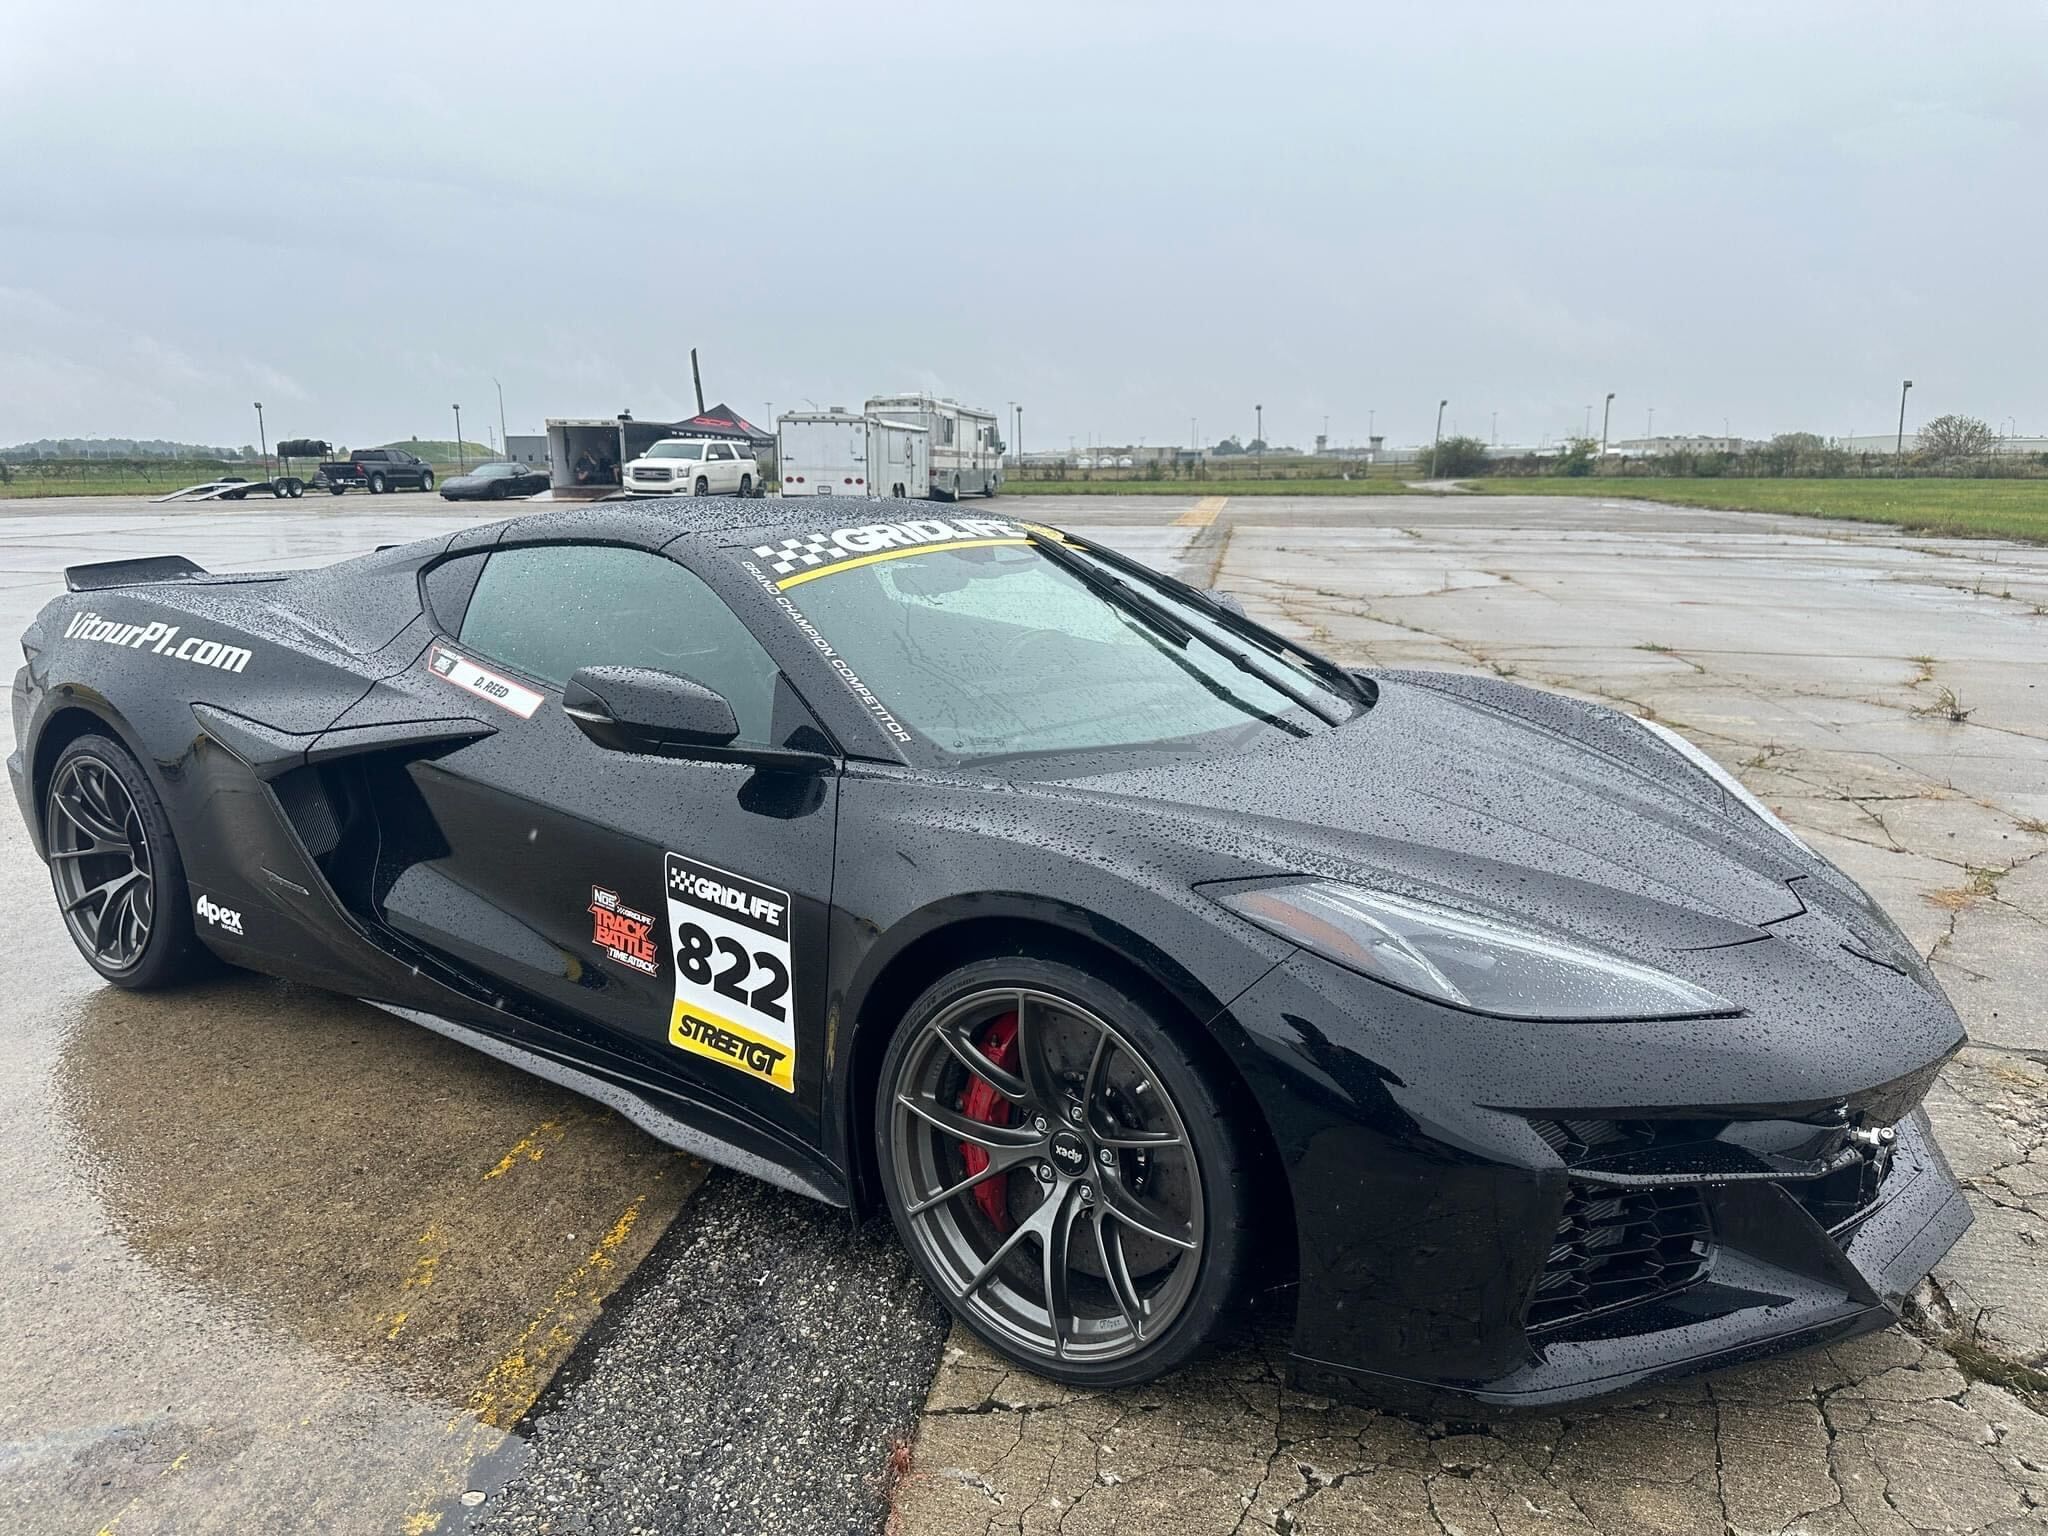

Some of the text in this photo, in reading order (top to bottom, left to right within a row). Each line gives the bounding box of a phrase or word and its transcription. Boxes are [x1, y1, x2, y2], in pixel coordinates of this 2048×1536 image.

[831, 519, 1027, 552] GRIDLIFE
[64, 611, 252, 673] VitourP1.com
[741, 561, 912, 742] GRAND CHAMPION COMPETITOR
[473, 676, 510, 698] D. REED
[197, 895, 242, 929] Apex
[594, 889, 618, 910] NOS
[694, 878, 784, 926] GRIDLIFE
[591, 906, 649, 942] TRACK
[597, 926, 655, 962] BATTLE
[677, 922, 789, 1024] 822
[1055, 1145, 1082, 1164] Apex
